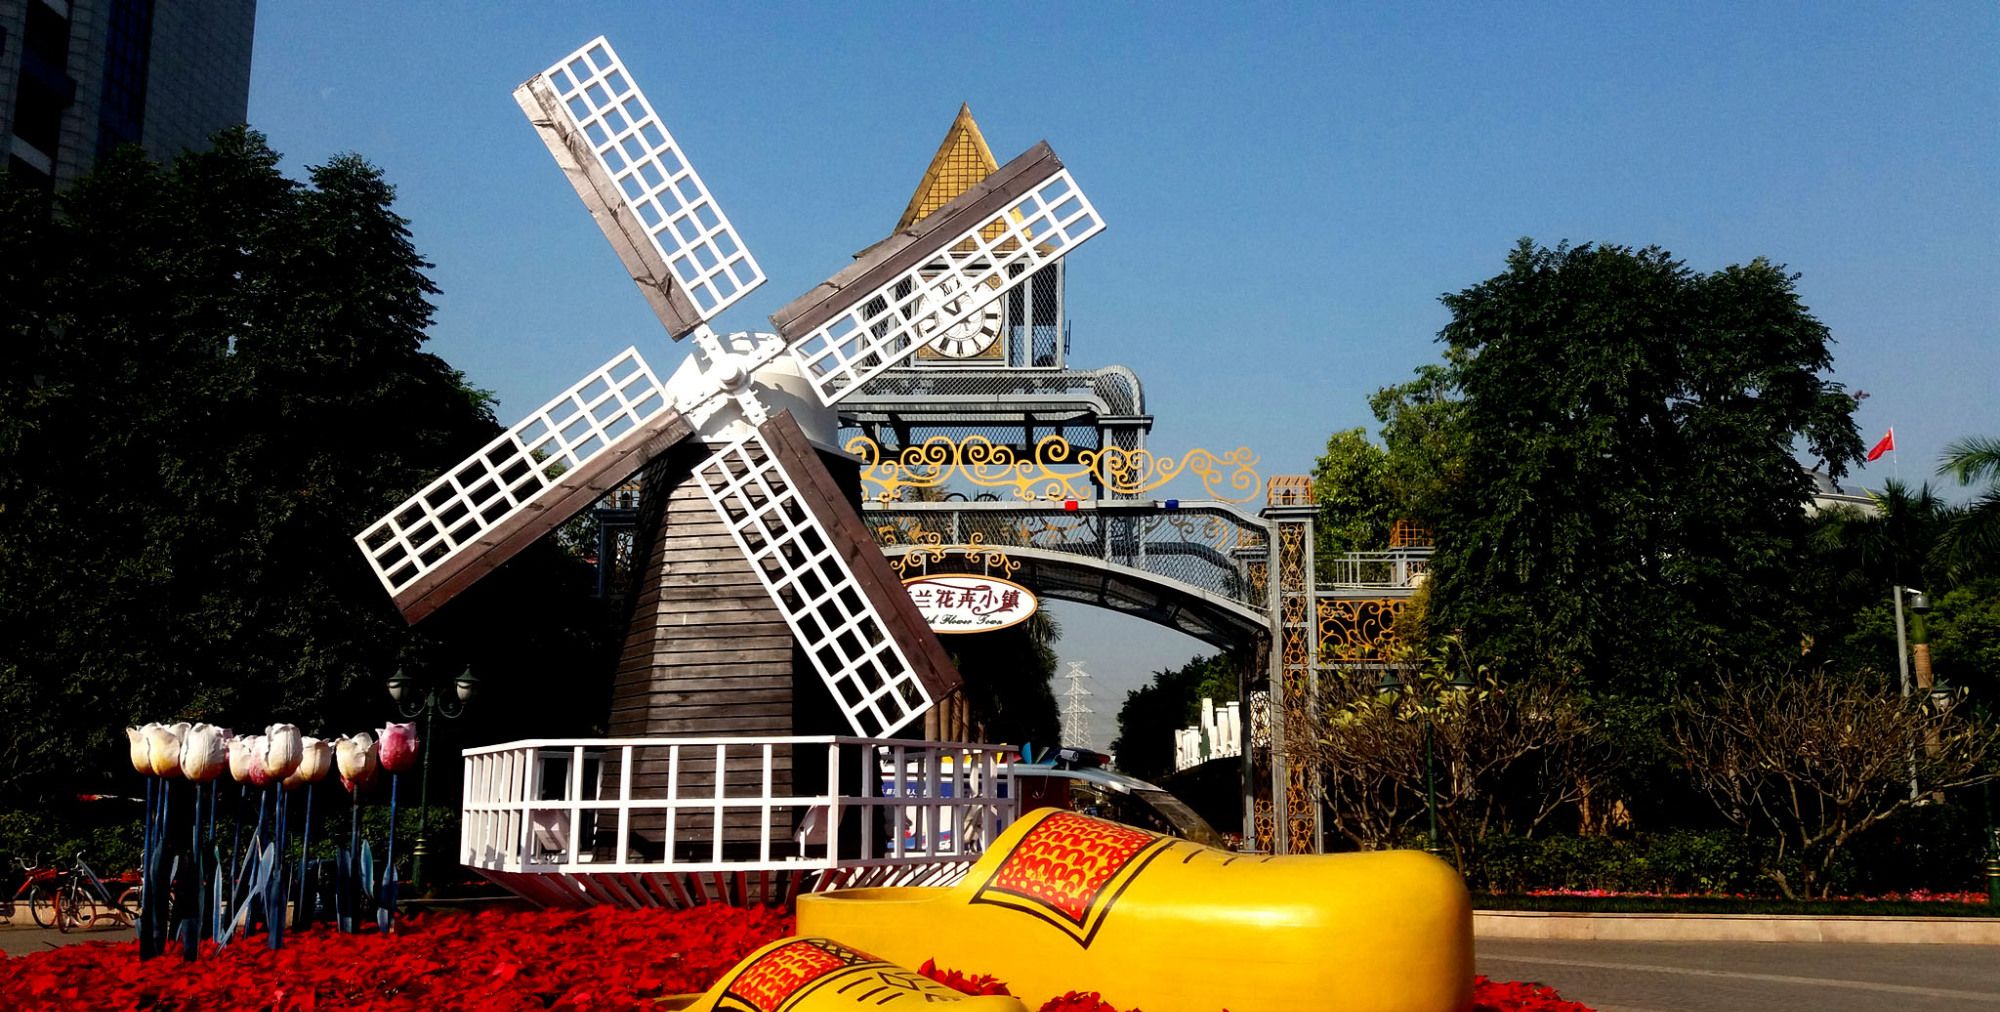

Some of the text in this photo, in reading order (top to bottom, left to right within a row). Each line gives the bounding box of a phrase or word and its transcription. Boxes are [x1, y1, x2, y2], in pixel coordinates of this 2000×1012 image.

[909, 588, 1021, 609] 兰花卉小镇
[939, 613, 973, 625] Flower
[976, 613, 1003, 625] Town
